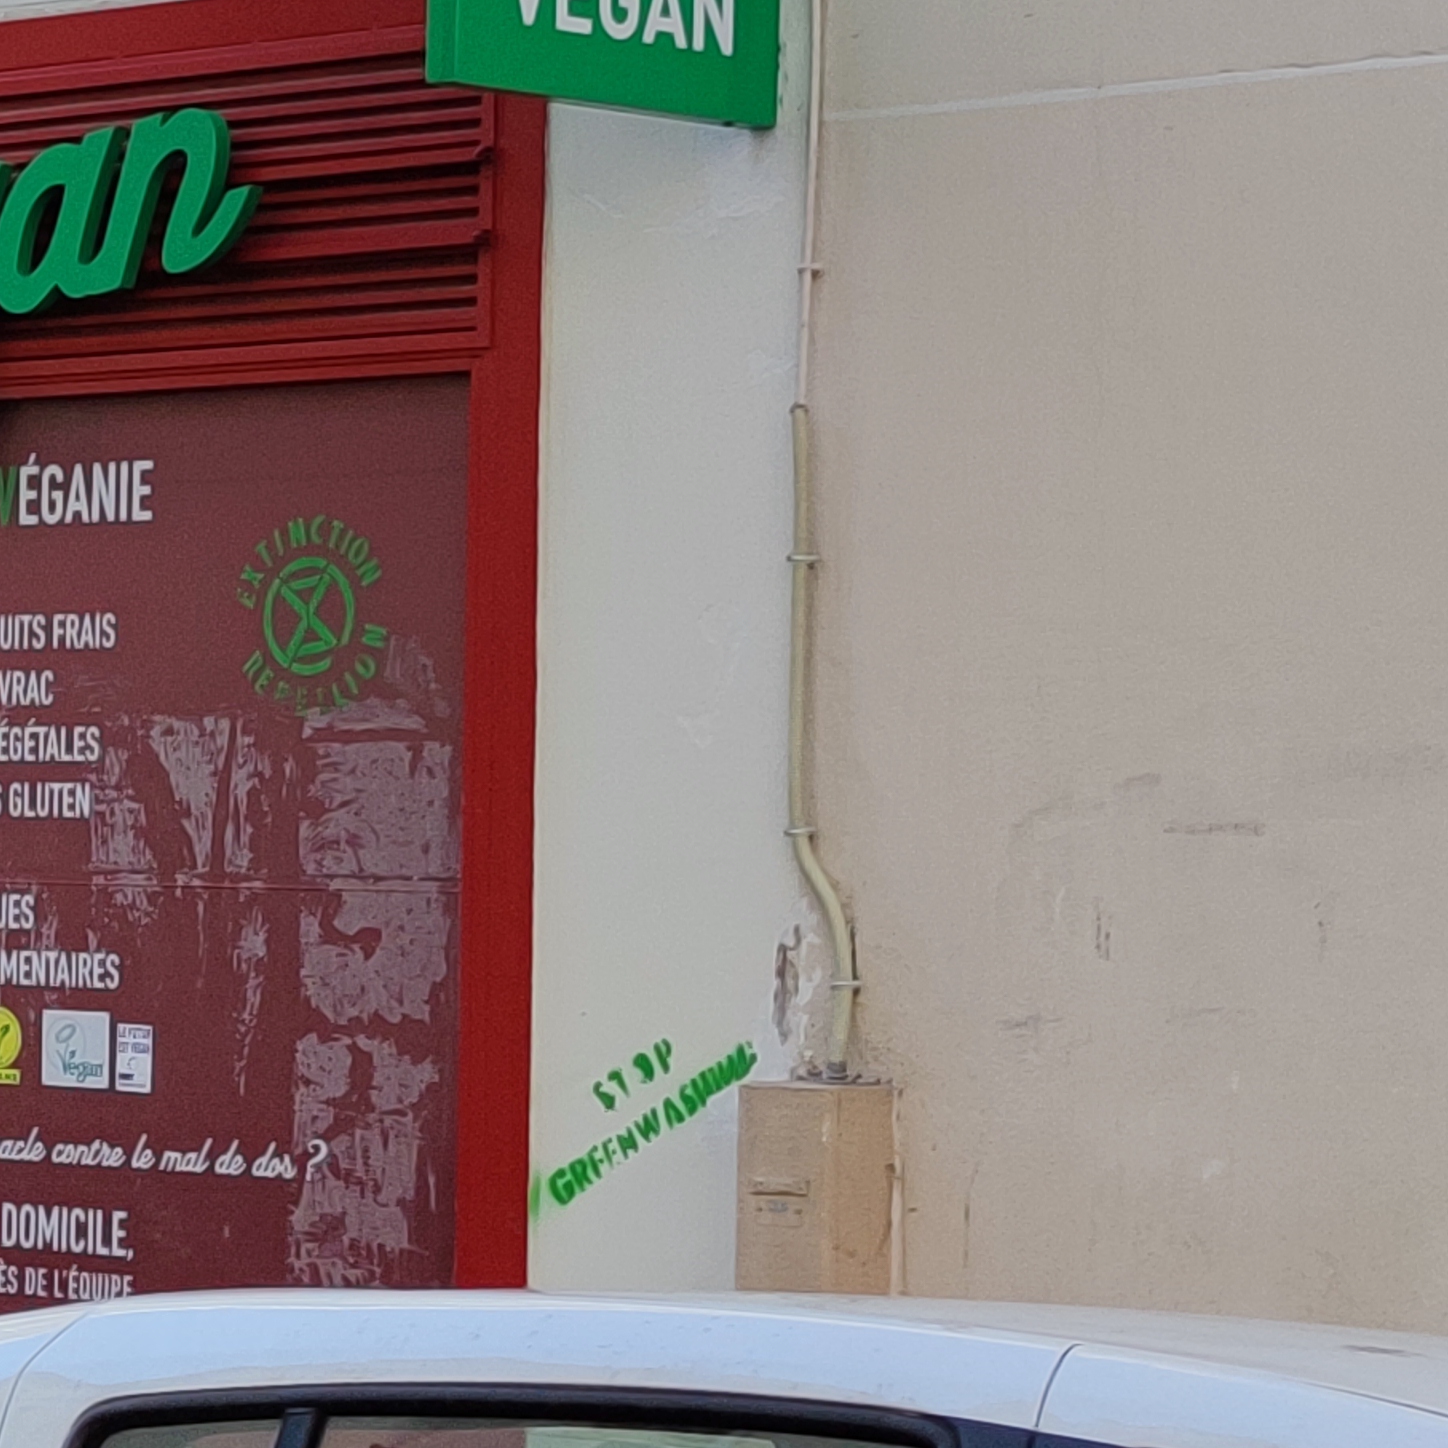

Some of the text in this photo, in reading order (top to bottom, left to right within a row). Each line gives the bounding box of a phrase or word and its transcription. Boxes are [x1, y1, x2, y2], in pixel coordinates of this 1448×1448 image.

[236, 513, 383, 610] EXTINCTION
[52, 611, 117, 650] FRAIS
[8, 781, 92, 820] GLUTEN
[56, 1046, 103, 1083] Vegan
[591, 1037, 674, 1113] STOP
[50, 1138, 127, 1169] contre
[130, 1132, 156, 1171] le
[157, 1137, 211, 1175] mal
[213, 1138, 247, 1177] de
[251, 1140, 298, 1180] dos
[304, 1137, 330, 1182] ?
[0, 1200, 135, 1262] DOMICILE,
[24, 1266, 48, 1298] DE
[53, 1263, 135, 1302] L'ÉQUIPE
